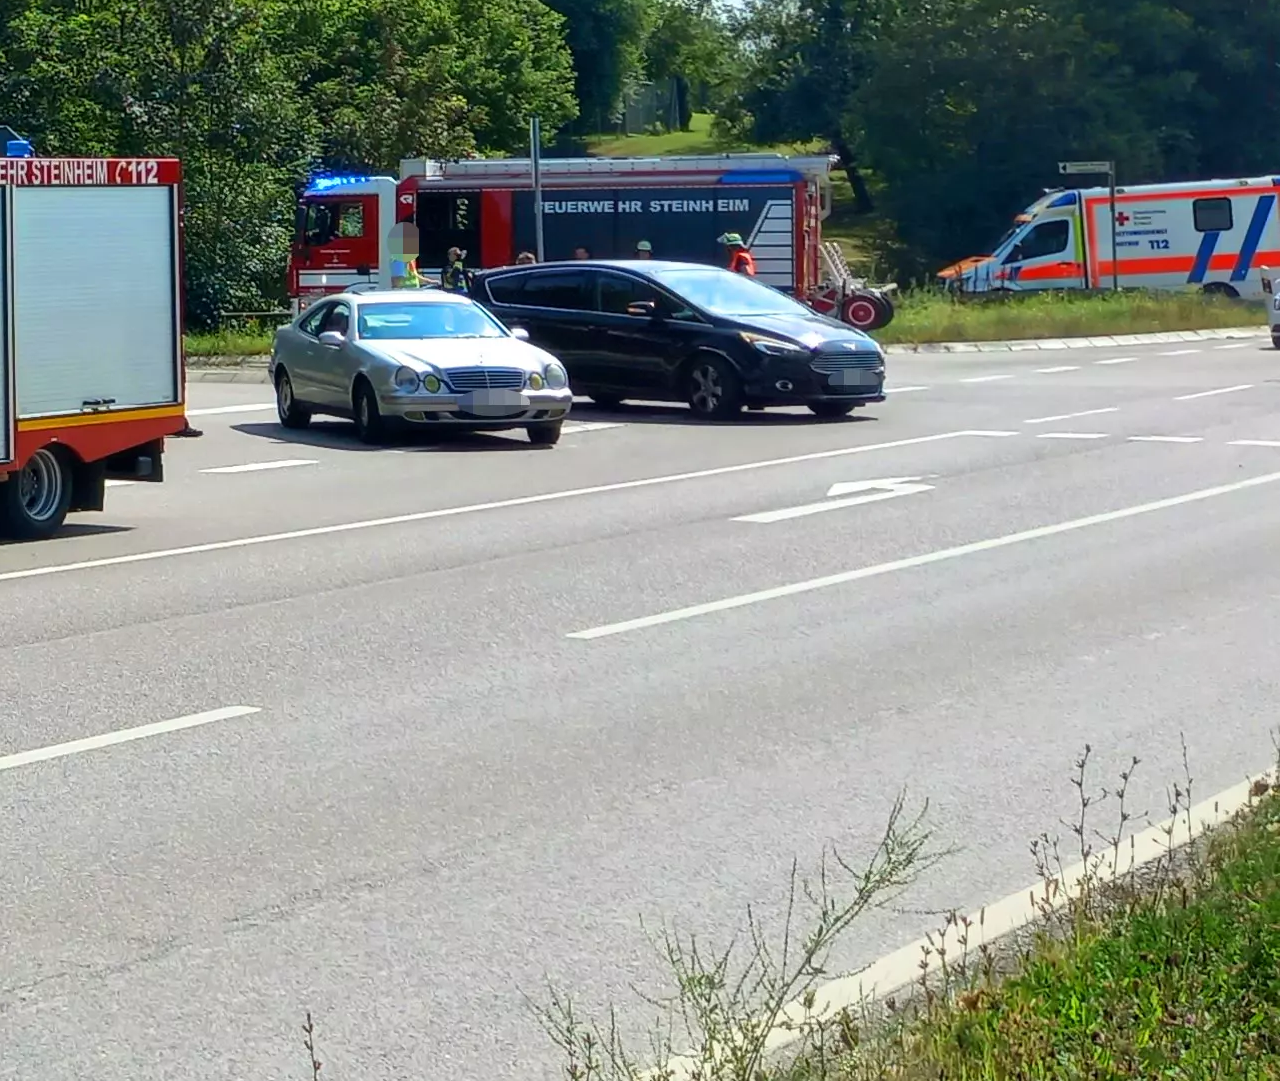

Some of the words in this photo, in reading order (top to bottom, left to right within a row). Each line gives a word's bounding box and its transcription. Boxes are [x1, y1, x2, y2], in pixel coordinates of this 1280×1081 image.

[31, 161, 107, 184] STEINHEIM
[127, 161, 158, 183] 112
[1148, 239, 1170, 250] 112
